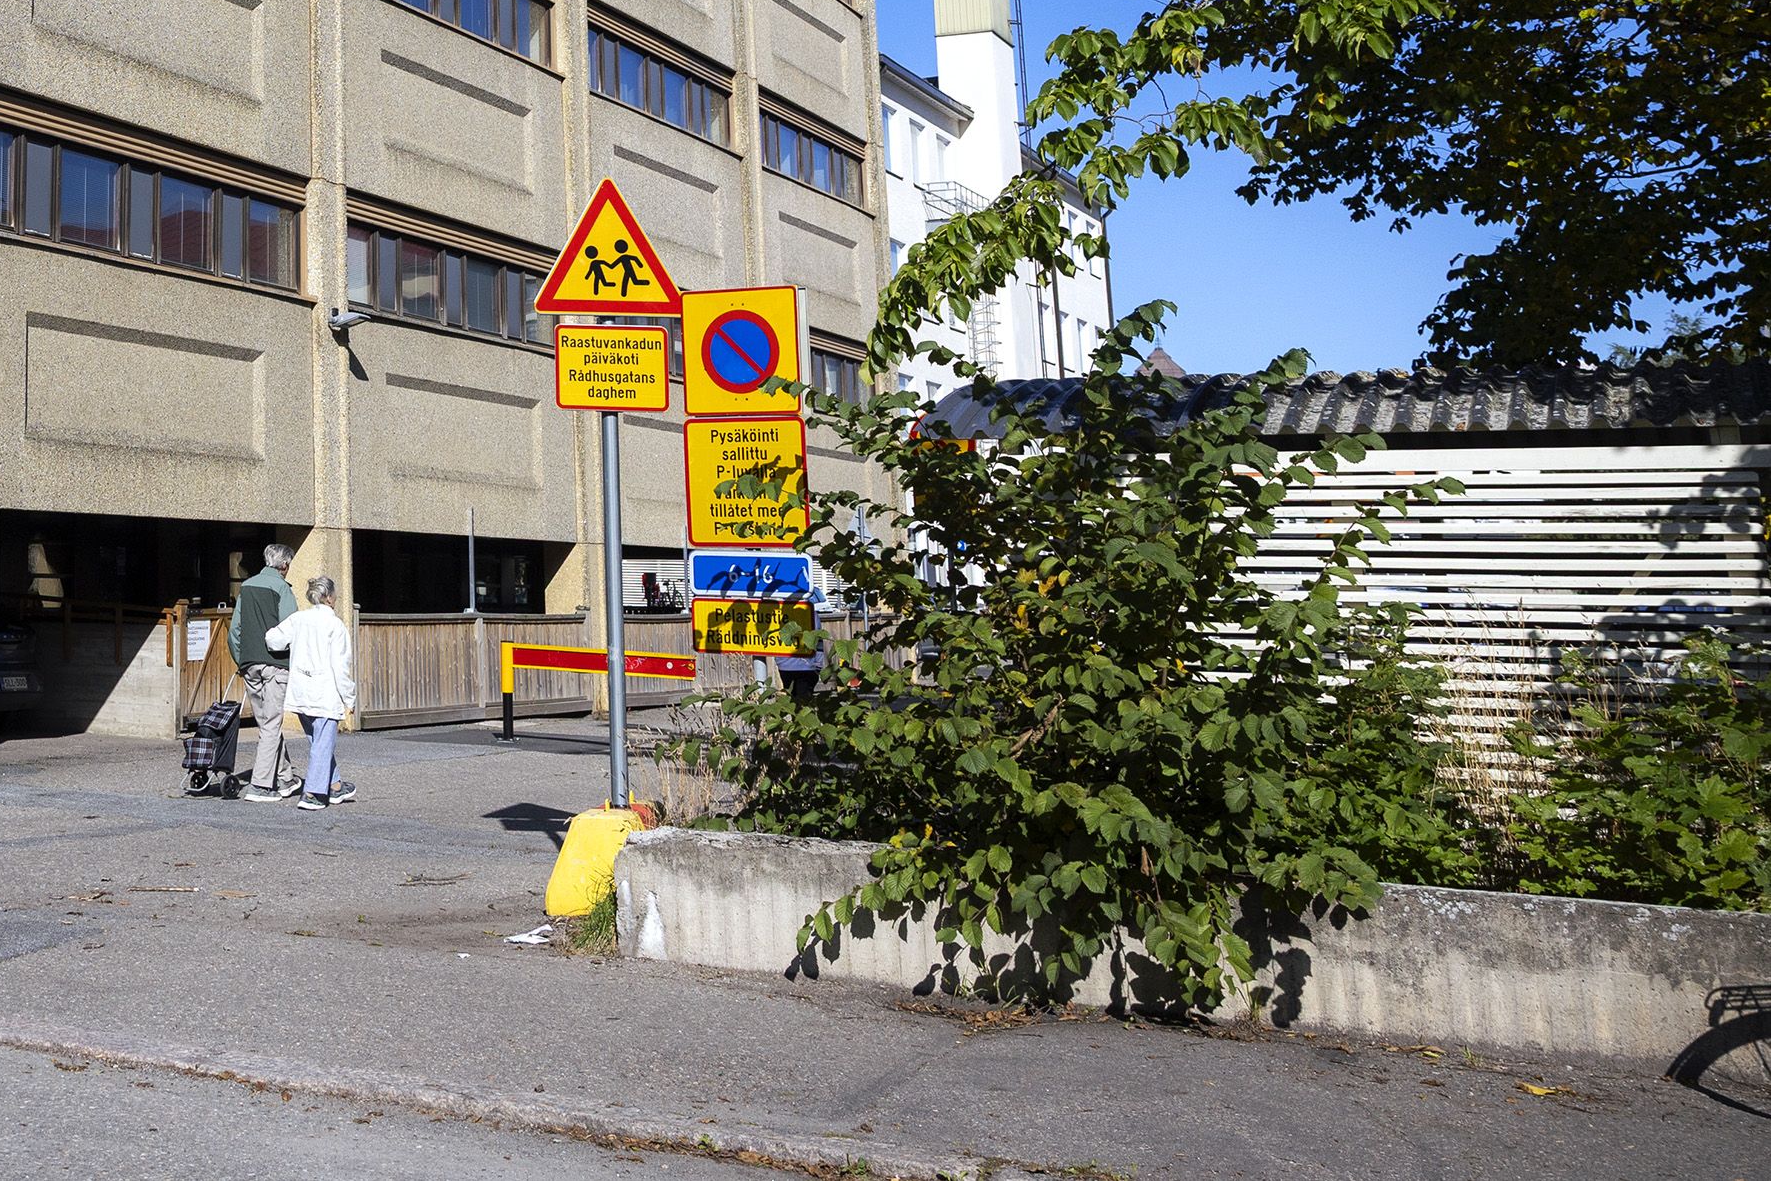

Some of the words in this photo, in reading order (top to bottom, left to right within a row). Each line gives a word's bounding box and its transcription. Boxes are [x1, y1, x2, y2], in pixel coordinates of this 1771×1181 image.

[561, 335, 662, 351] Raastuvankadun
[583, 351, 639, 366] päiväkoti
[569, 369, 656, 385] Rådhusgatans
[588, 385, 637, 401] daghem
[710, 428, 779, 445] Pysäköinti
[722, 446, 768, 461] sallittu
[709, 503, 753, 518] tillåtet
[728, 563, 774, 584] 6-16
[715, 607, 789, 624] Pelastustie
[707, 627, 800, 650] Räddningsvg
